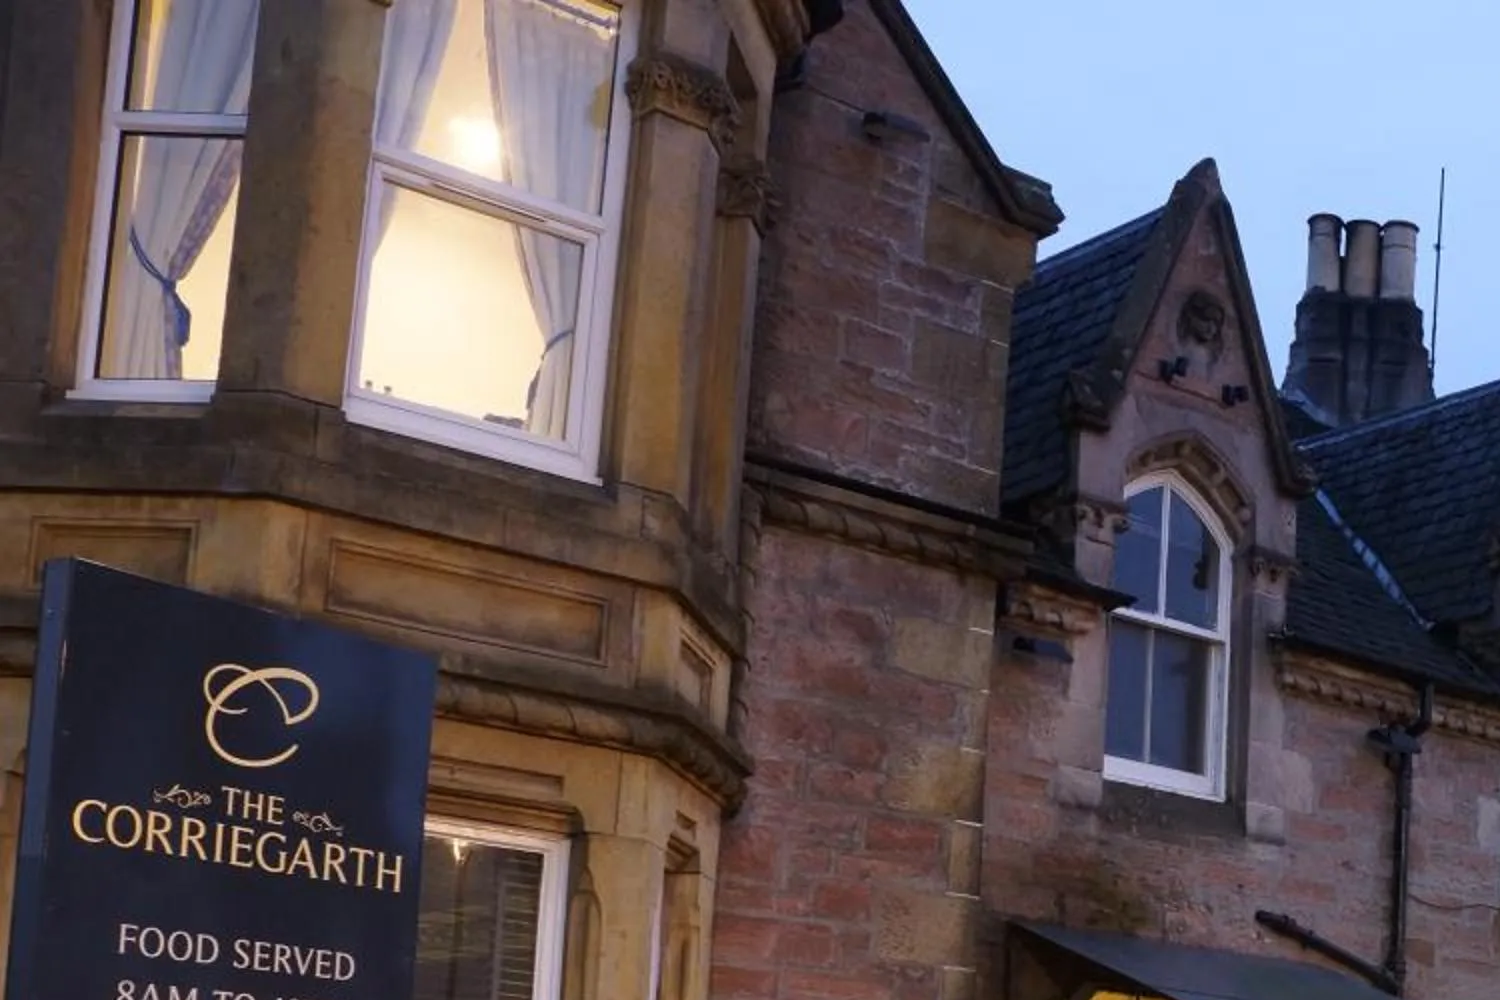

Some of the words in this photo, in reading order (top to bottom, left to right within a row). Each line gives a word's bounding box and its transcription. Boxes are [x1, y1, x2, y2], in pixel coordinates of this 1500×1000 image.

[221, 786, 285, 825] THE
[72, 799, 403, 893] CORRIEGARTH
[117, 923, 219, 964] FOOD
[232, 939, 356, 982] SERVED
